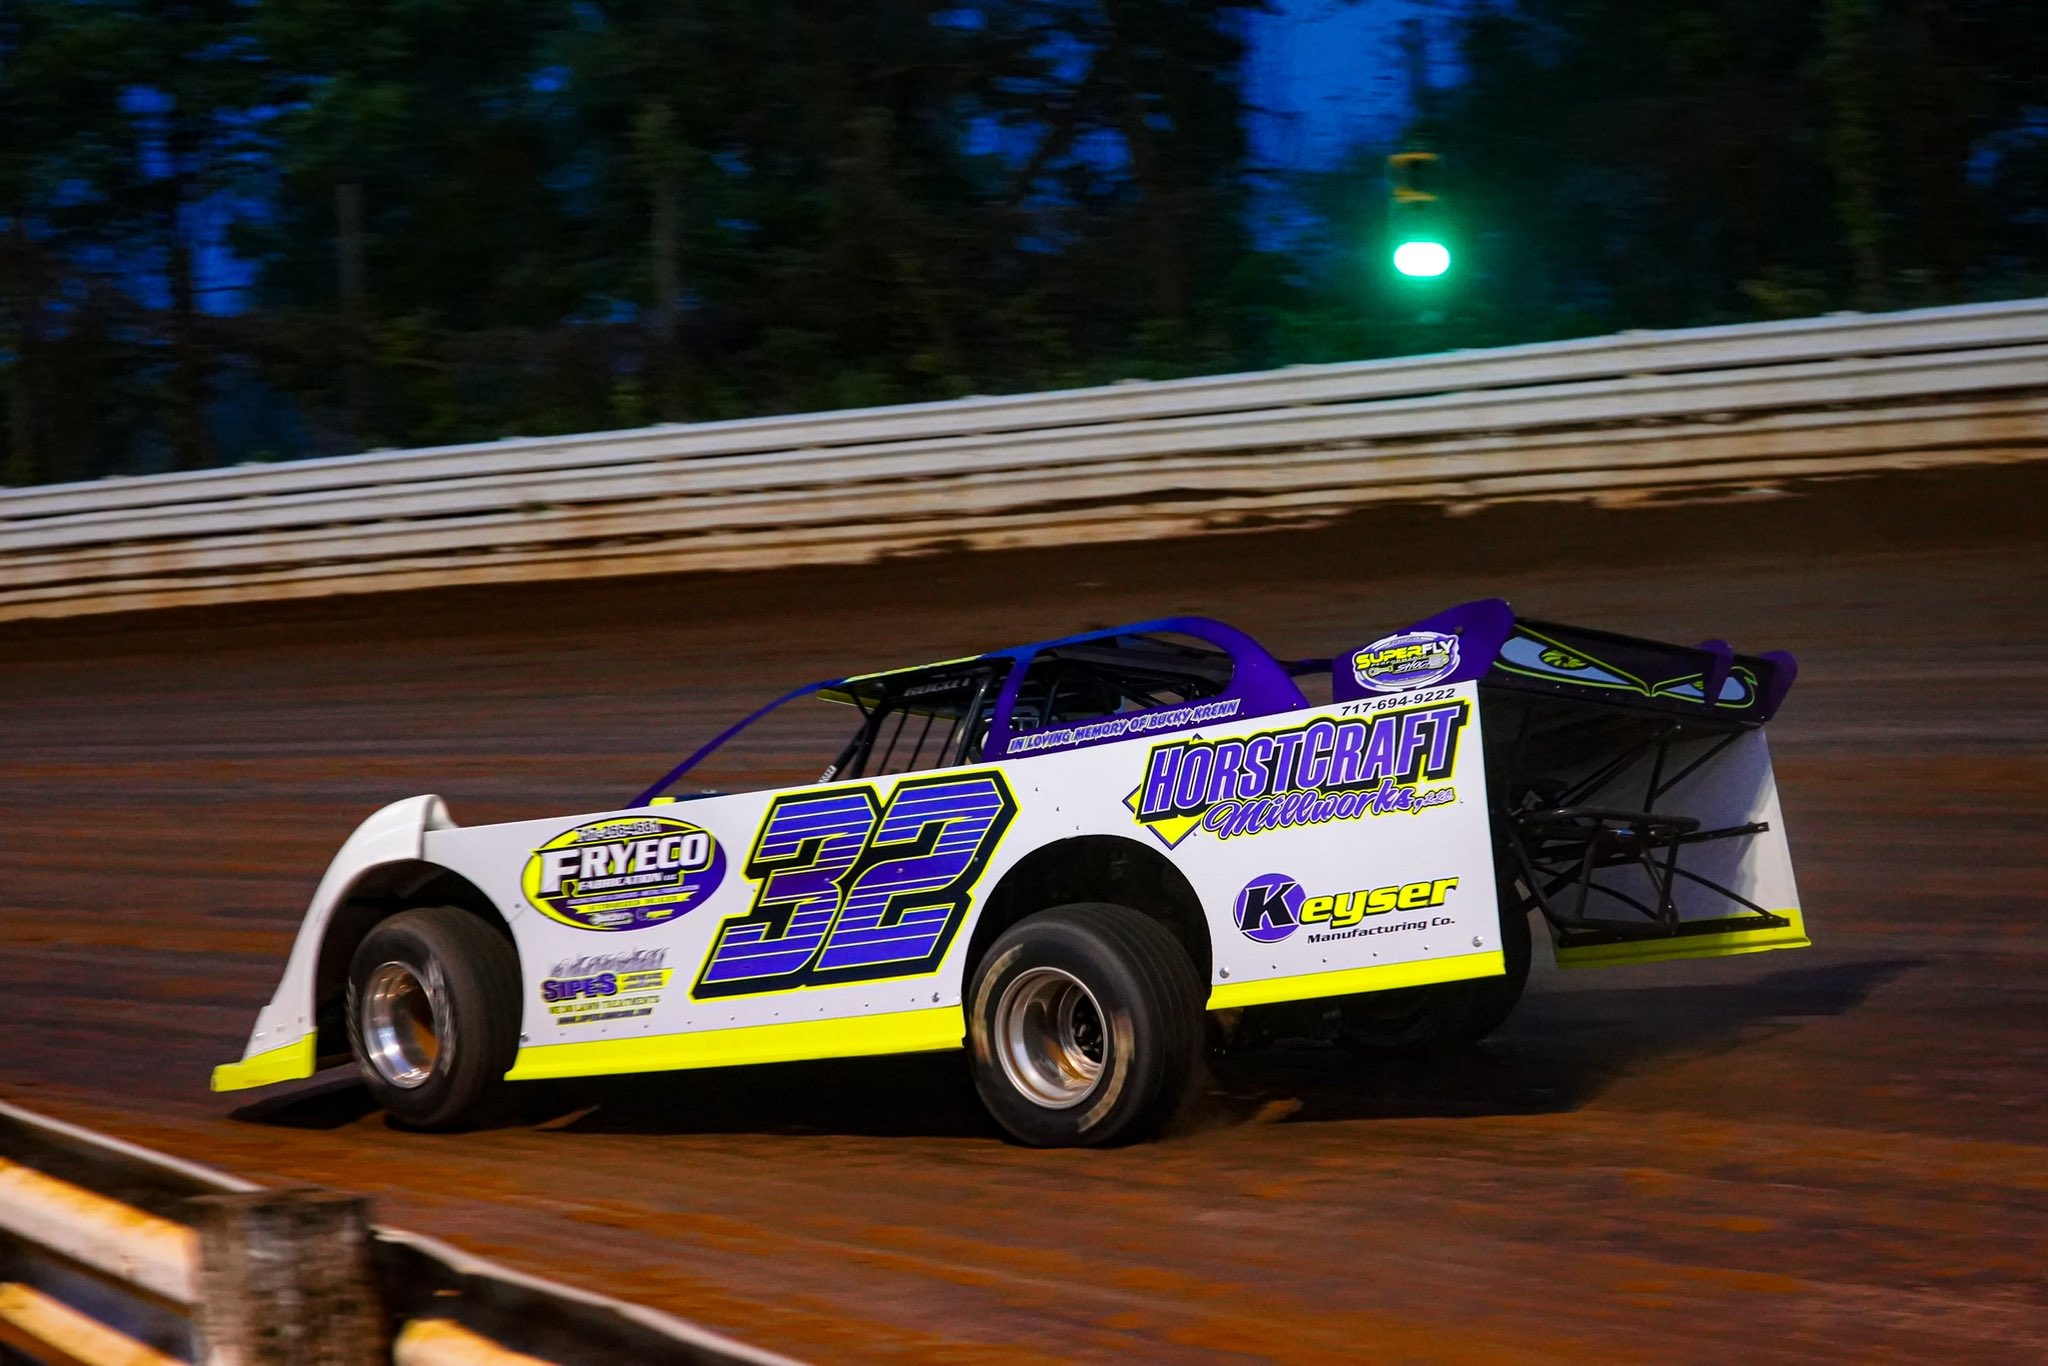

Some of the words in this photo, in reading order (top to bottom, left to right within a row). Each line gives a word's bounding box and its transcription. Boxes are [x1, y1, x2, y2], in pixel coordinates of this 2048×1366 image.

[1356, 638, 1455, 671] SUPERFLY
[1342, 688, 1456, 716] 717-694-9222
[1007, 737, 1025, 754] IN
[1025, 729, 1072, 750] LOVING
[1072, 720, 1128, 746] MEMORY
[1129, 716, 1148, 732] OF
[1148, 709, 1191, 729] BUCKY
[1191, 699, 1241, 723] KRENN
[1140, 703, 1466, 818] HORSTCRAFT
[538, 831, 709, 895] FRYECO
[577, 871, 662, 891] FABRICATION
[692, 771, 1018, 999] 32
[1239, 876, 1460, 932] Keyser
[1307, 919, 1427, 944] Manufacturing
[1432, 915, 1455, 928] Co.
[542, 972, 618, 1002] SIPES
